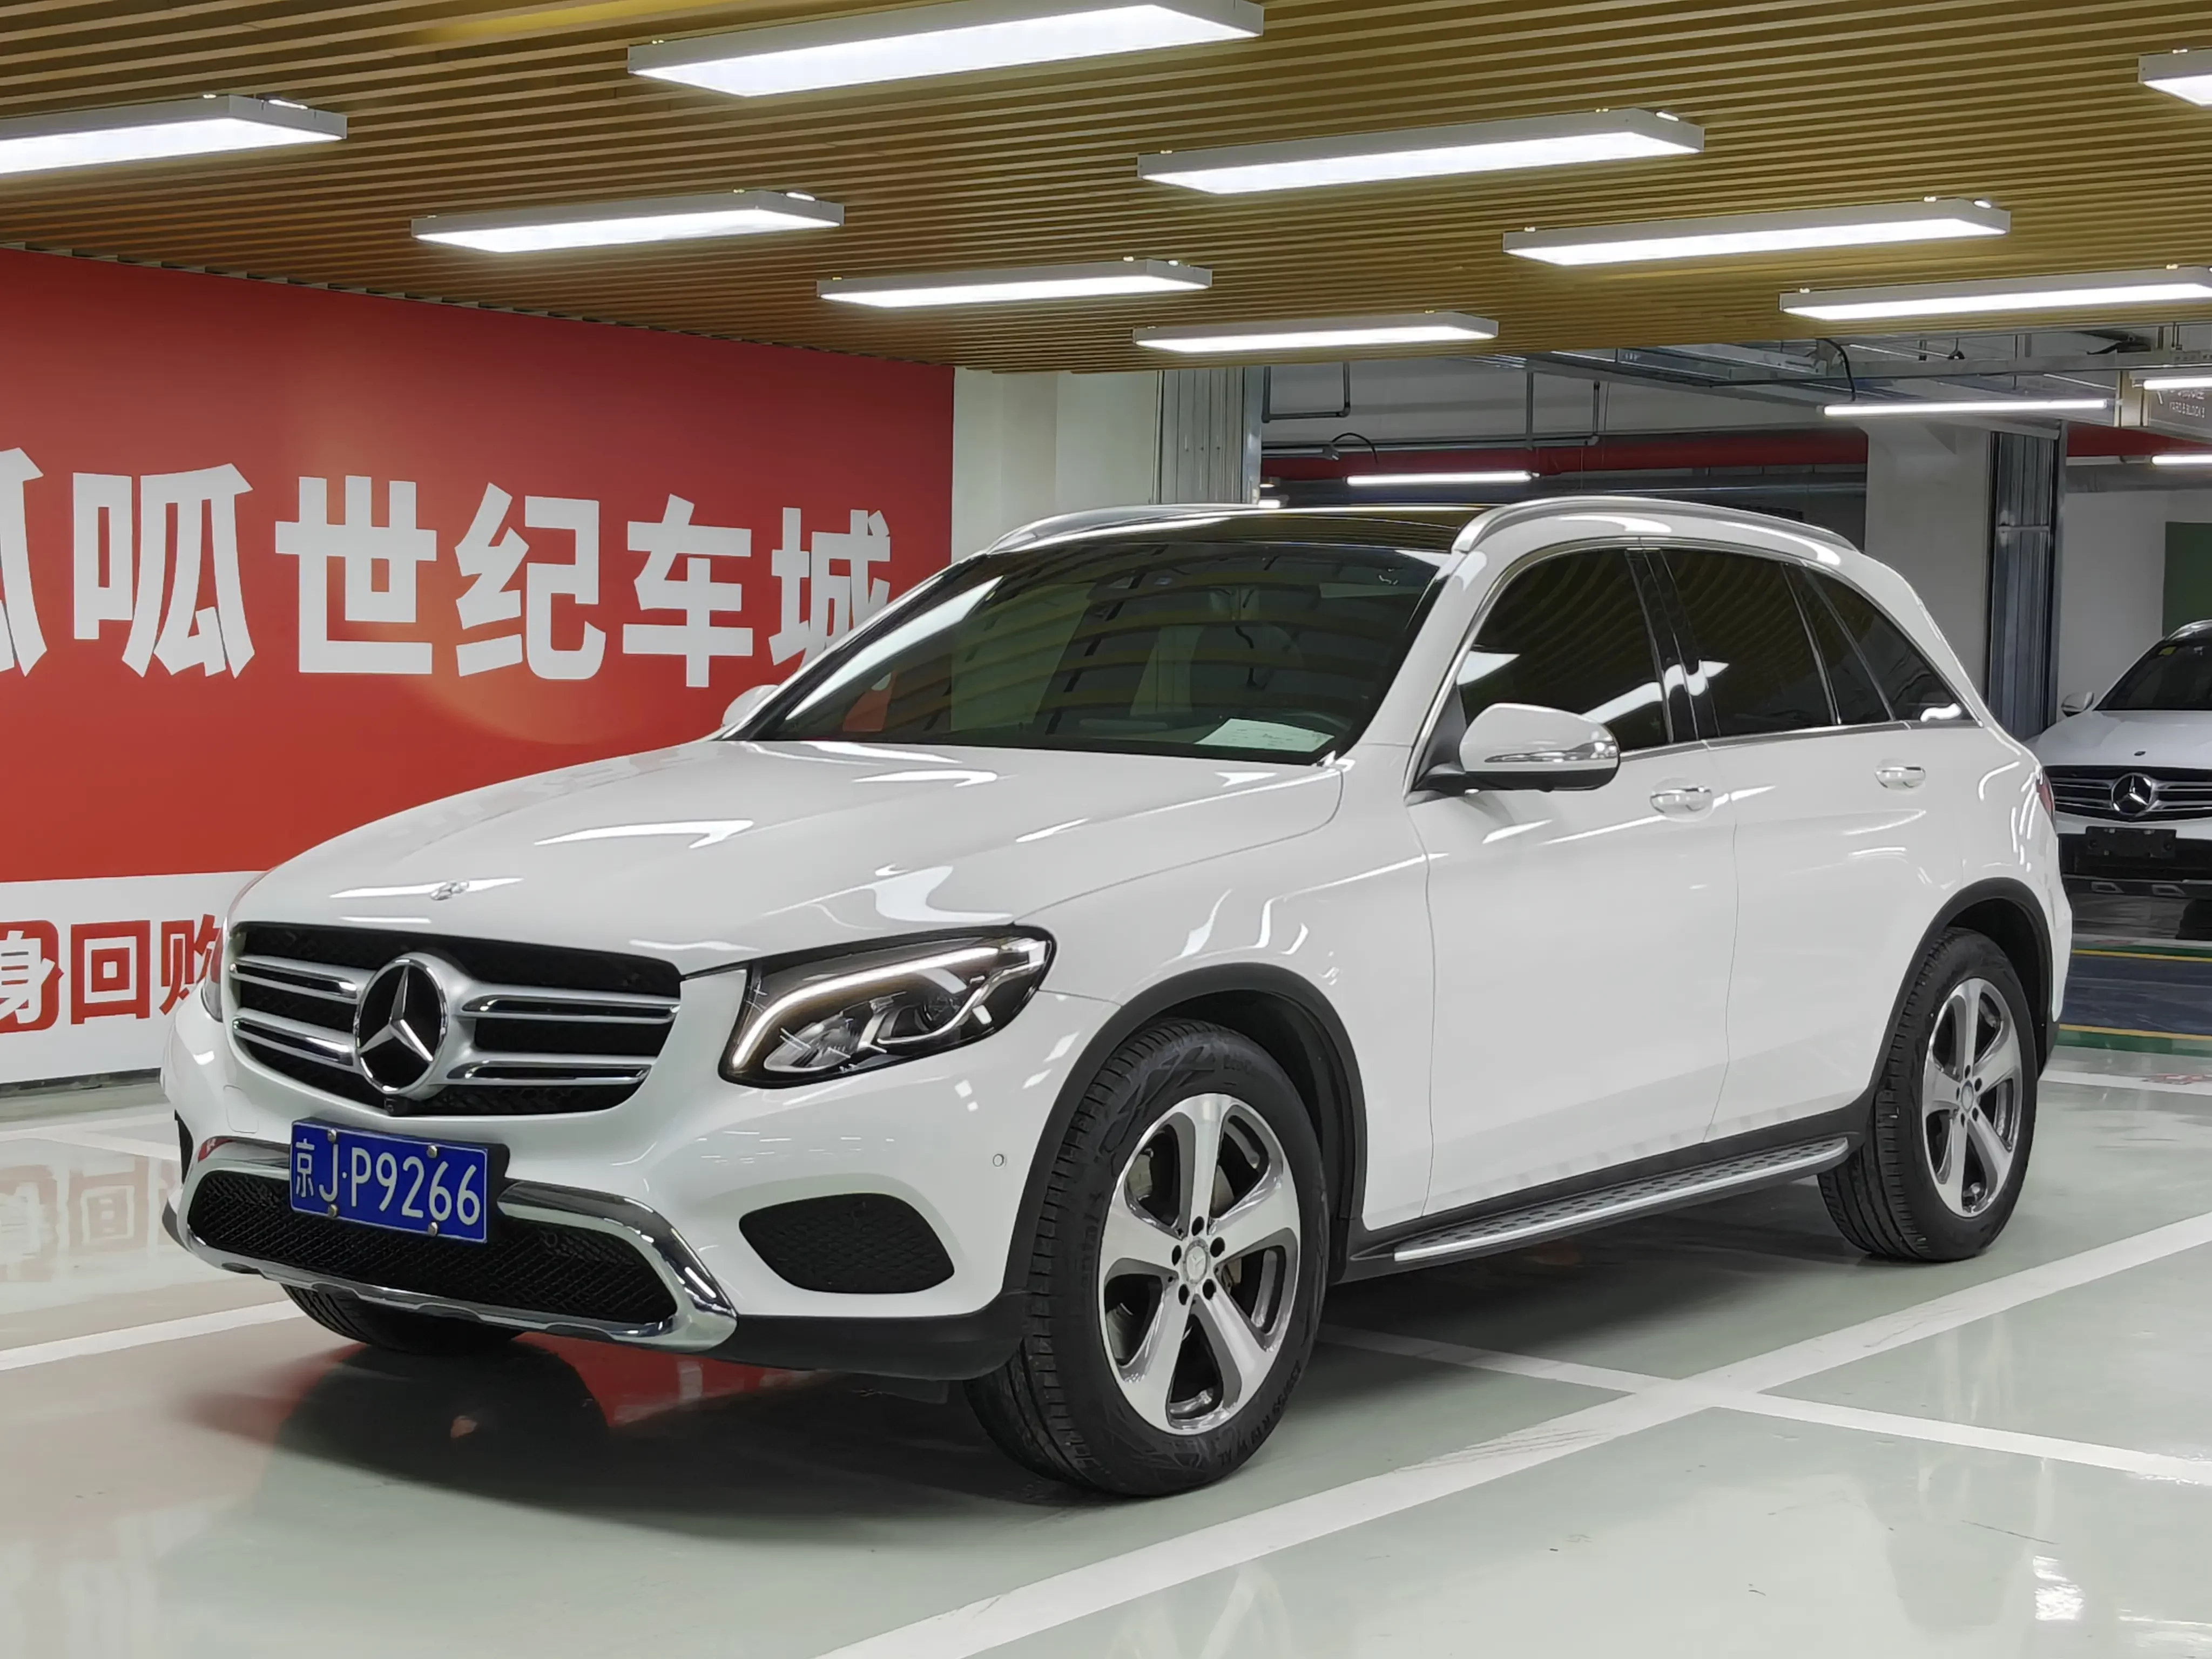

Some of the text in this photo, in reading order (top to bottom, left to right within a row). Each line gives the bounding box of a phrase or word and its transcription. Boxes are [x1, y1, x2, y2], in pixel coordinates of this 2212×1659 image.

[0, 448, 891, 687] 呱世纪车城
